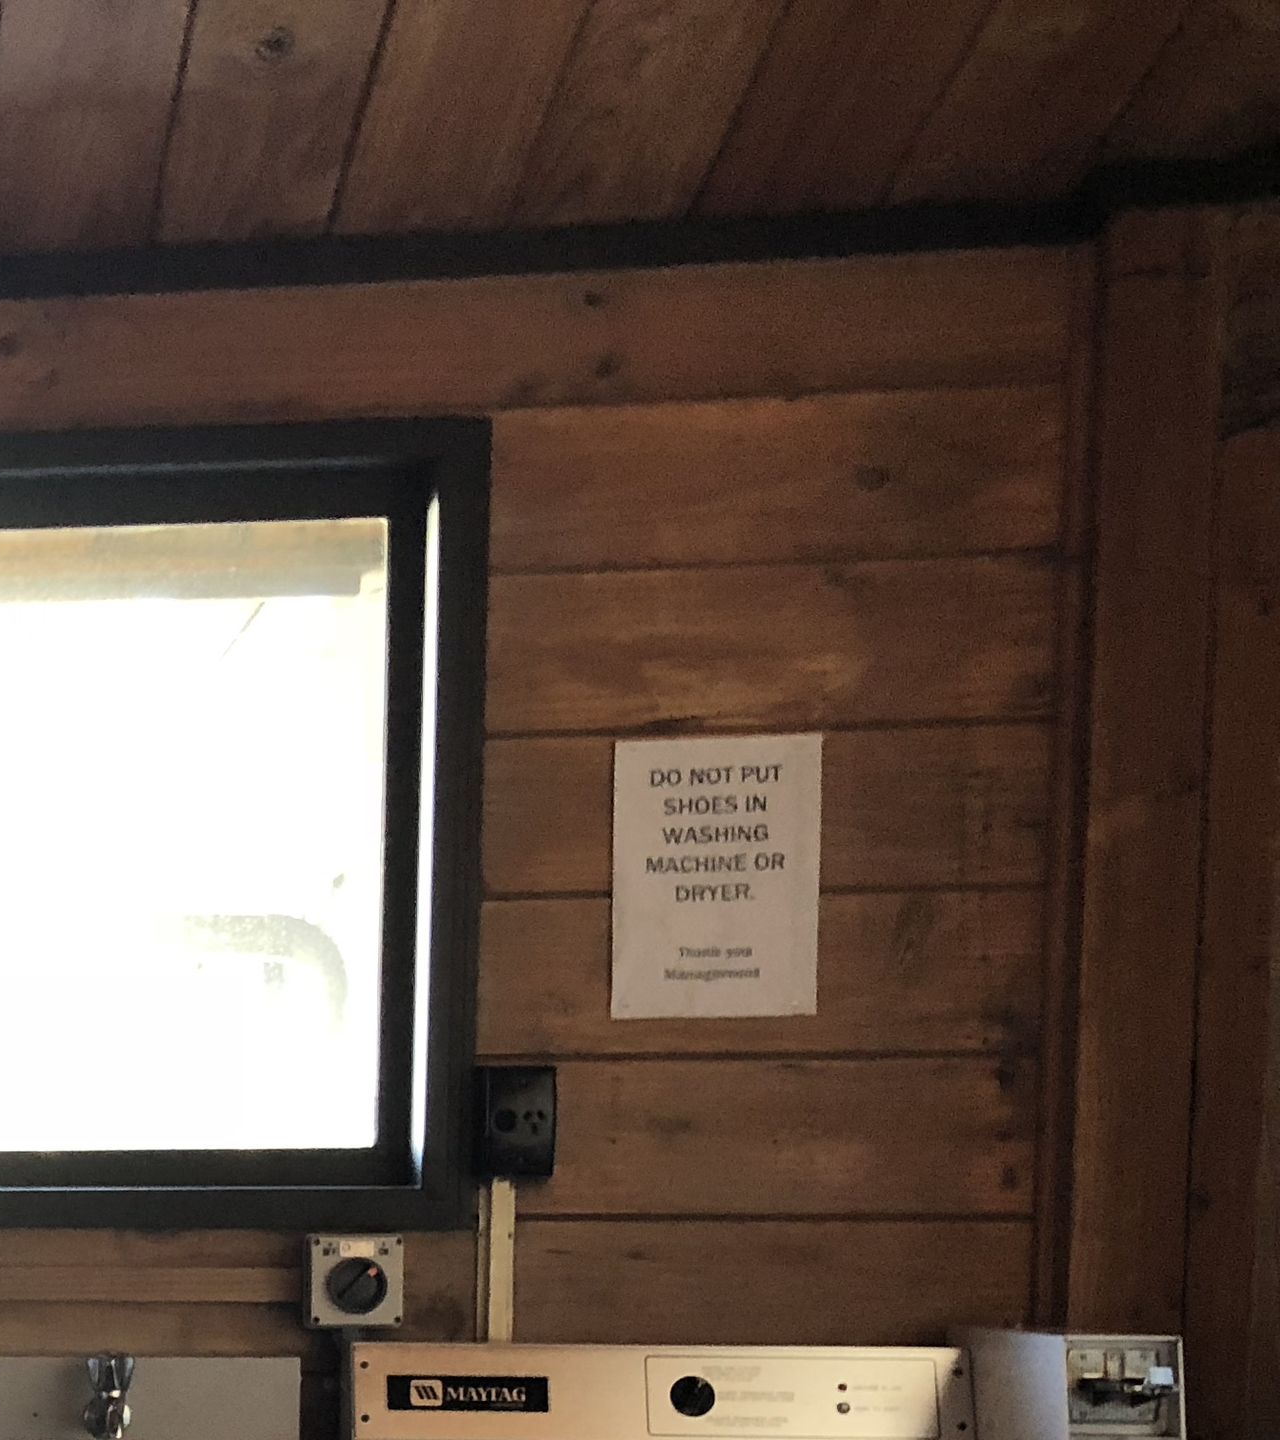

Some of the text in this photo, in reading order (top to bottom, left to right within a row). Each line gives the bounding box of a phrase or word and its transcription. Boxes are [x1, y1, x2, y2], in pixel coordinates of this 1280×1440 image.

[649, 764, 783, 788] DO NOT PUT
[663, 795, 768, 815] SHOES IN
[662, 824, 770, 845] WASHING
[646, 853, 785, 874] MACHINE OR
[446, 1386, 527, 1402] MAYTAG
